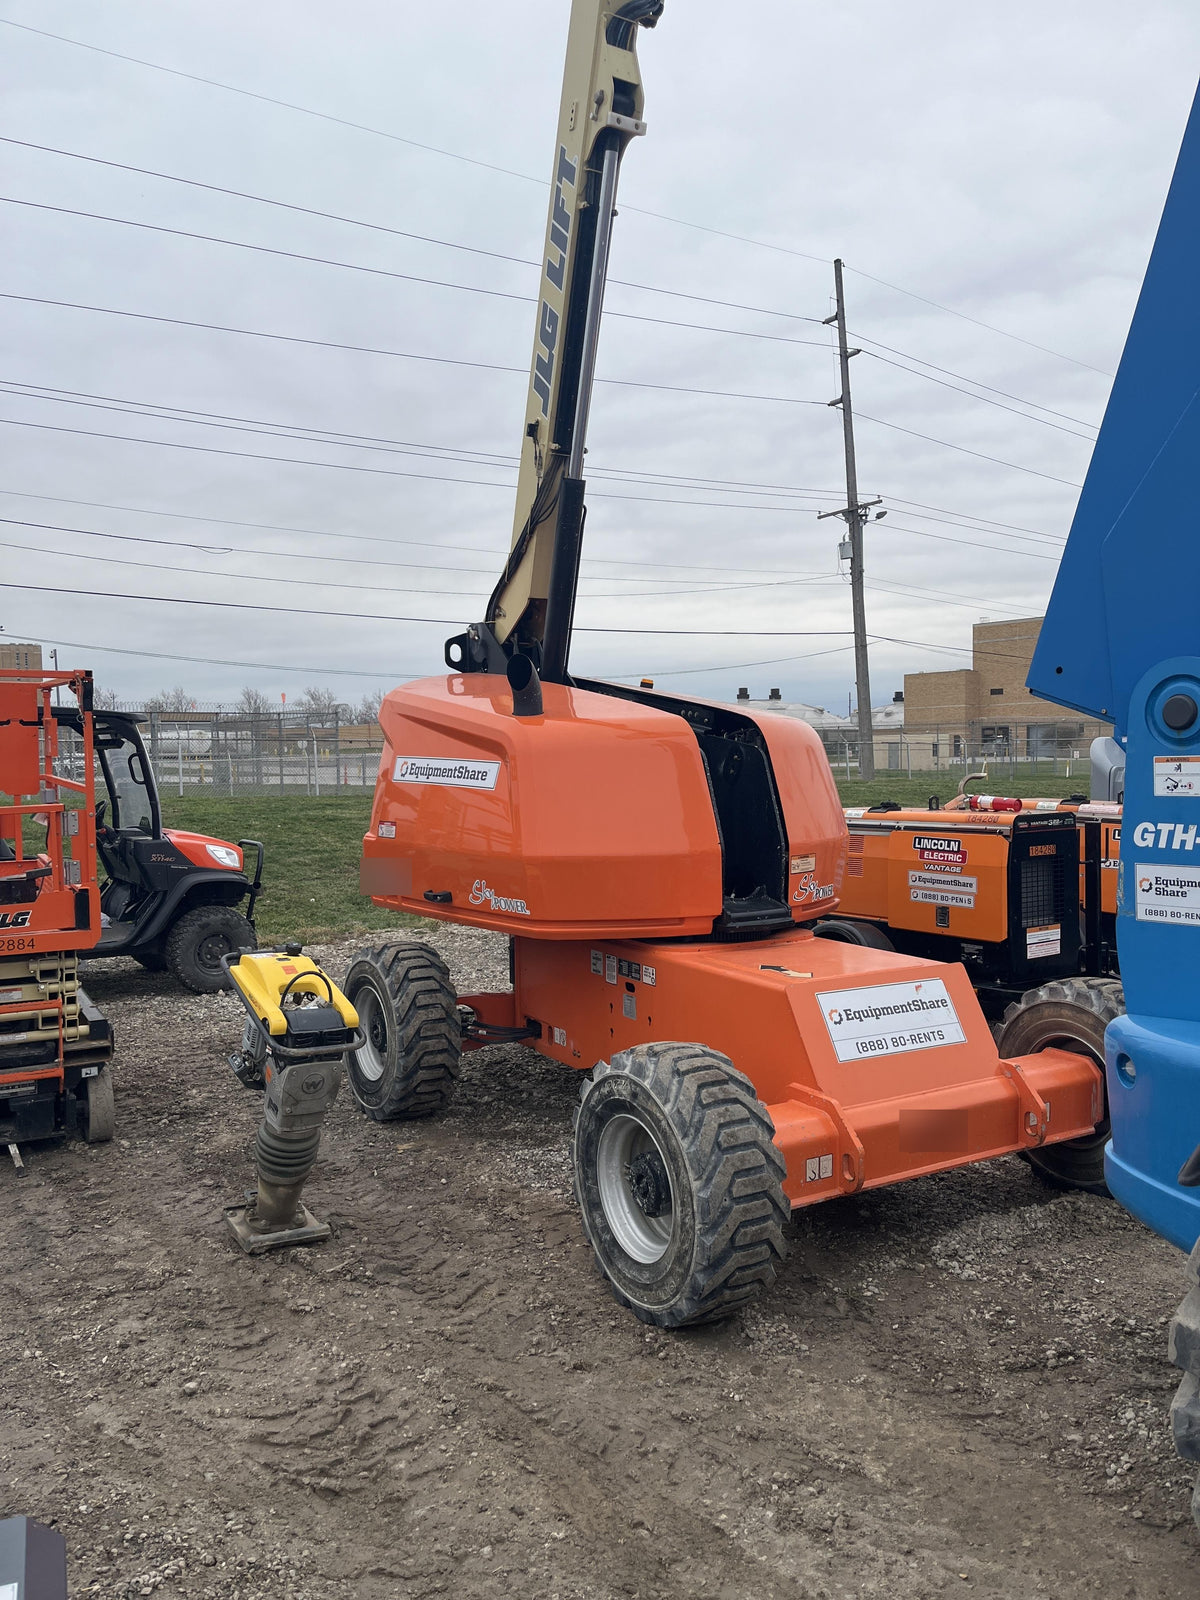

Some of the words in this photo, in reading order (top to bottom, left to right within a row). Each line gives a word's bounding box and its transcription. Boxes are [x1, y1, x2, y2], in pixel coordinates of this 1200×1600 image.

[533, 299, 559, 420] JLG
[546, 144, 577, 293] LIFT
[409, 763, 488, 781] EquipmentShare
[915, 838, 959, 851] LINCOLN
[924, 851, 963, 862] ELECTRIC
[924, 863, 963, 873] VANTAGE
[918, 876, 974, 888] EquipmentShare
[1155, 887, 1188, 898] Share
[0, 910, 31, 928] LG
[1145, 908, 1168, 917] (888)
[844, 998, 949, 1022] EquipmentShare
[856, 1038, 889, 1054] (888)
[891, 1030, 945, 1048] 80-RENTS
